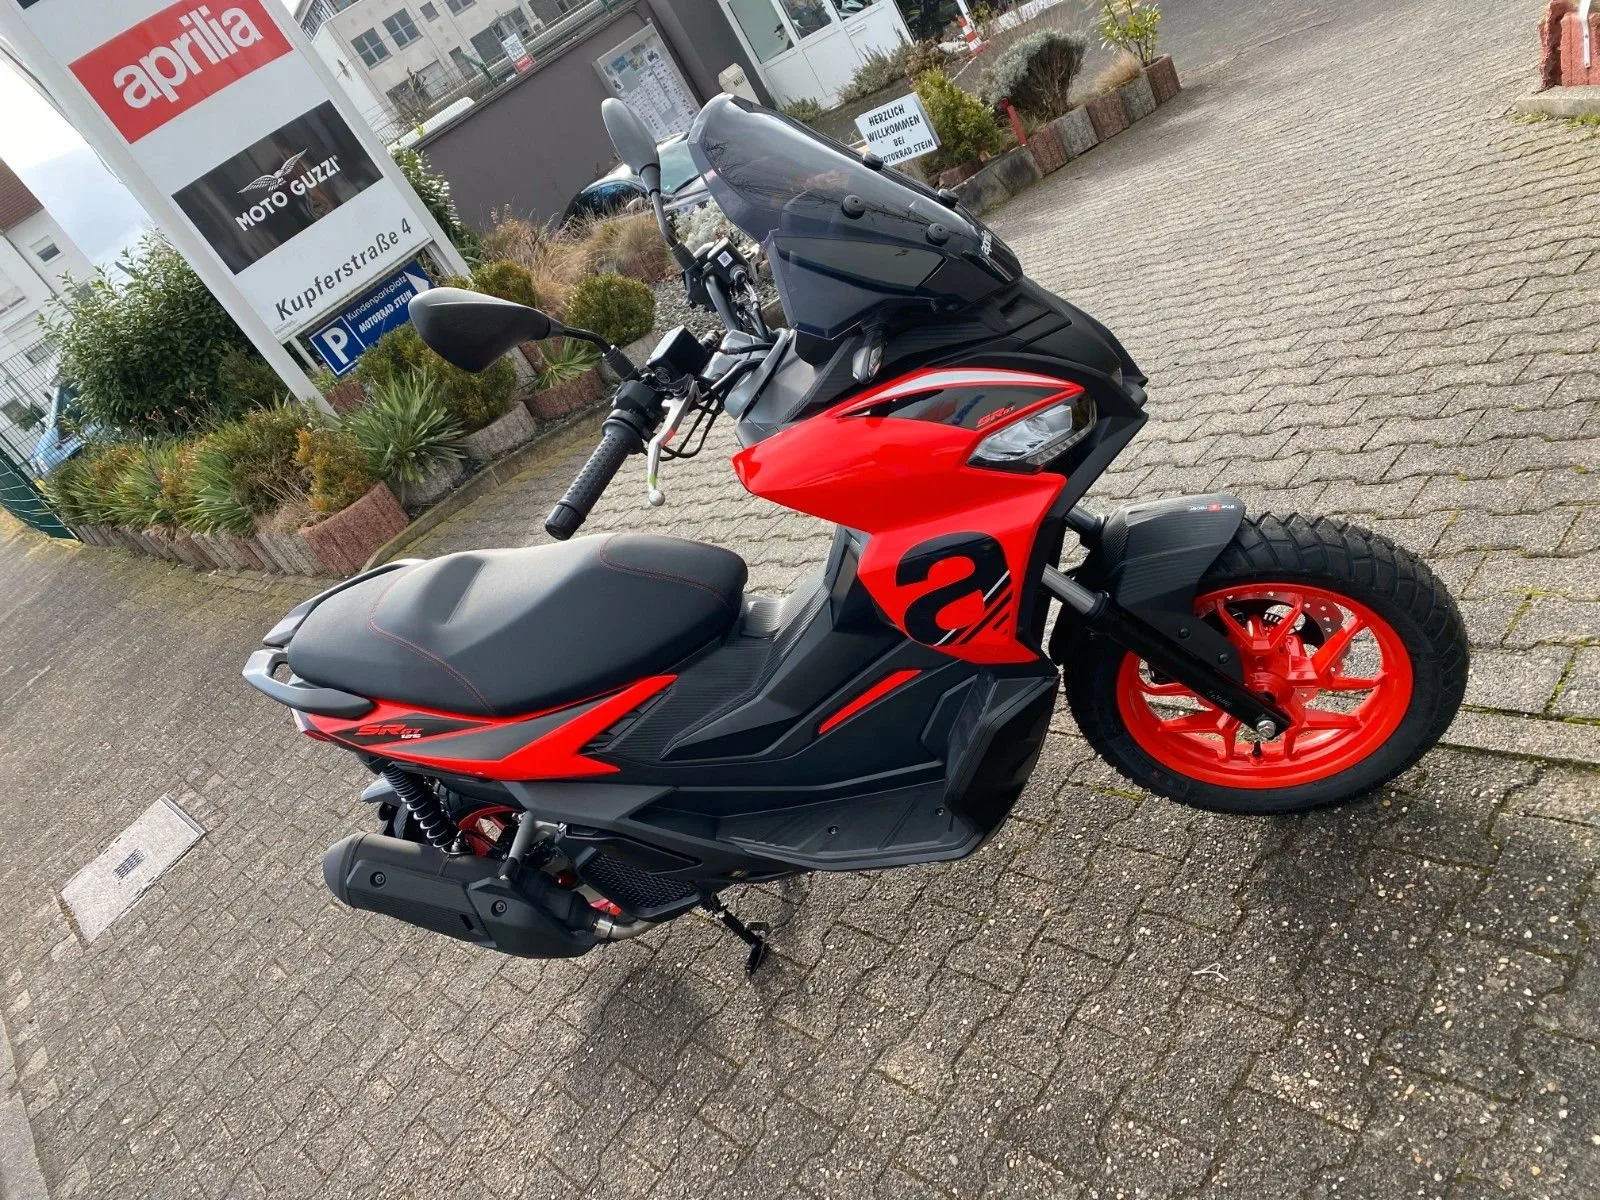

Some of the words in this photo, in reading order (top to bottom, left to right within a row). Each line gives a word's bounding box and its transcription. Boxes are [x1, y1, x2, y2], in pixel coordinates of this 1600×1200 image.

[113, 6, 264, 109] aprilia
[866, 114, 921, 143] WILLKOMMEN
[868, 104, 905, 127] HERZLICH
[881, 146, 913, 164] OTORRAD
[913, 139, 934, 153] STEIN
[893, 136, 906, 147] BEI
[235, 193, 288, 231] MOTO
[290, 157, 341, 196] GUZZI
[274, 232, 399, 321] Kupferstraße
[401, 217, 412, 235] 4
[346, 275, 407, 321] Kundenparkplatz
[358, 303, 394, 333] MOTORRAD
[393, 289, 413, 308] STEIN
[321, 327, 349, 365] P
